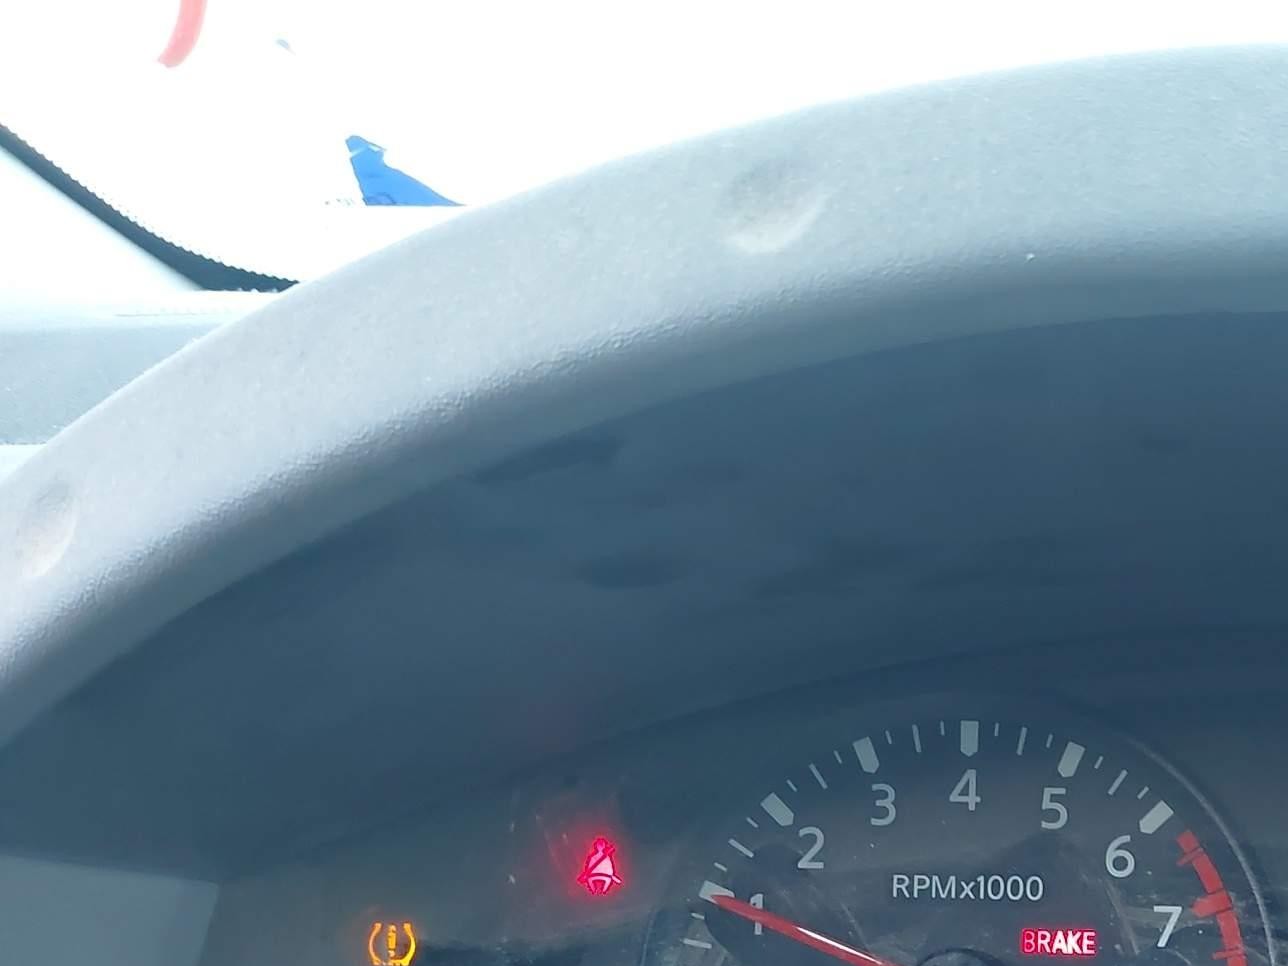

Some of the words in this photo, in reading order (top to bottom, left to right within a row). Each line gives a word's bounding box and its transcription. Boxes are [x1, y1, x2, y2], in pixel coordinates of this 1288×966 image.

[871, 784, 897, 826] 3
[949, 770, 981, 811] 4
[1041, 788, 1068, 829] 5
[798, 827, 825, 869] 2
[1105, 836, 1134, 878] 6
[892, 874, 1044, 900] RPMx1000
[749, 894, 764, 935] 1
[1153, 906, 1182, 947] 7
[1023, 929, 1096, 955] BRAKE
